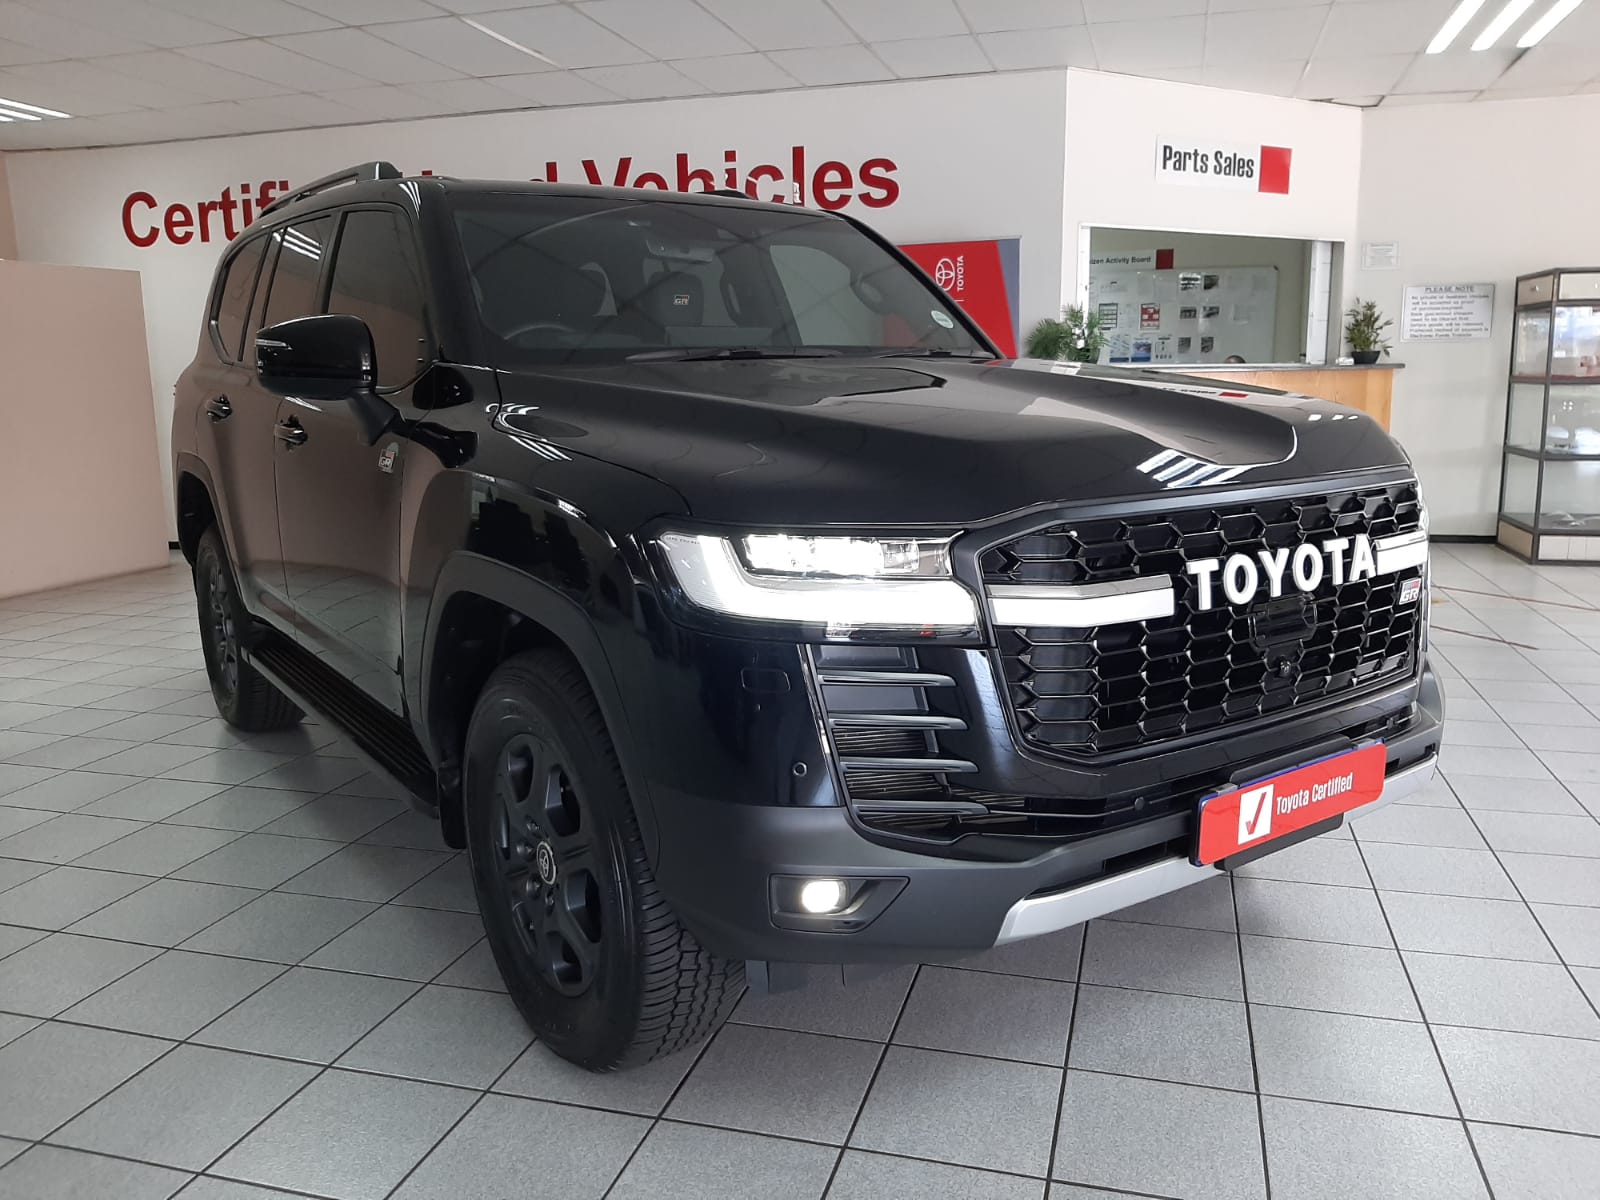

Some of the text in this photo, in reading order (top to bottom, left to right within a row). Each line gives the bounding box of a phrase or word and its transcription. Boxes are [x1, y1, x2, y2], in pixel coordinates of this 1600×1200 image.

[1162, 145, 1255, 179] Parts Sales
[122, 179, 289, 247] Certif
[956, 255, 965, 292] TOYOTA
[1106, 256, 1130, 265] Activity
[1131, 255, 1152, 263] Board
[1425, 285, 1475, 294] PLEASE NOTE
[1186, 533, 1377, 611] TOYOTA
[1276, 772, 1354, 816] Toyota Certified
